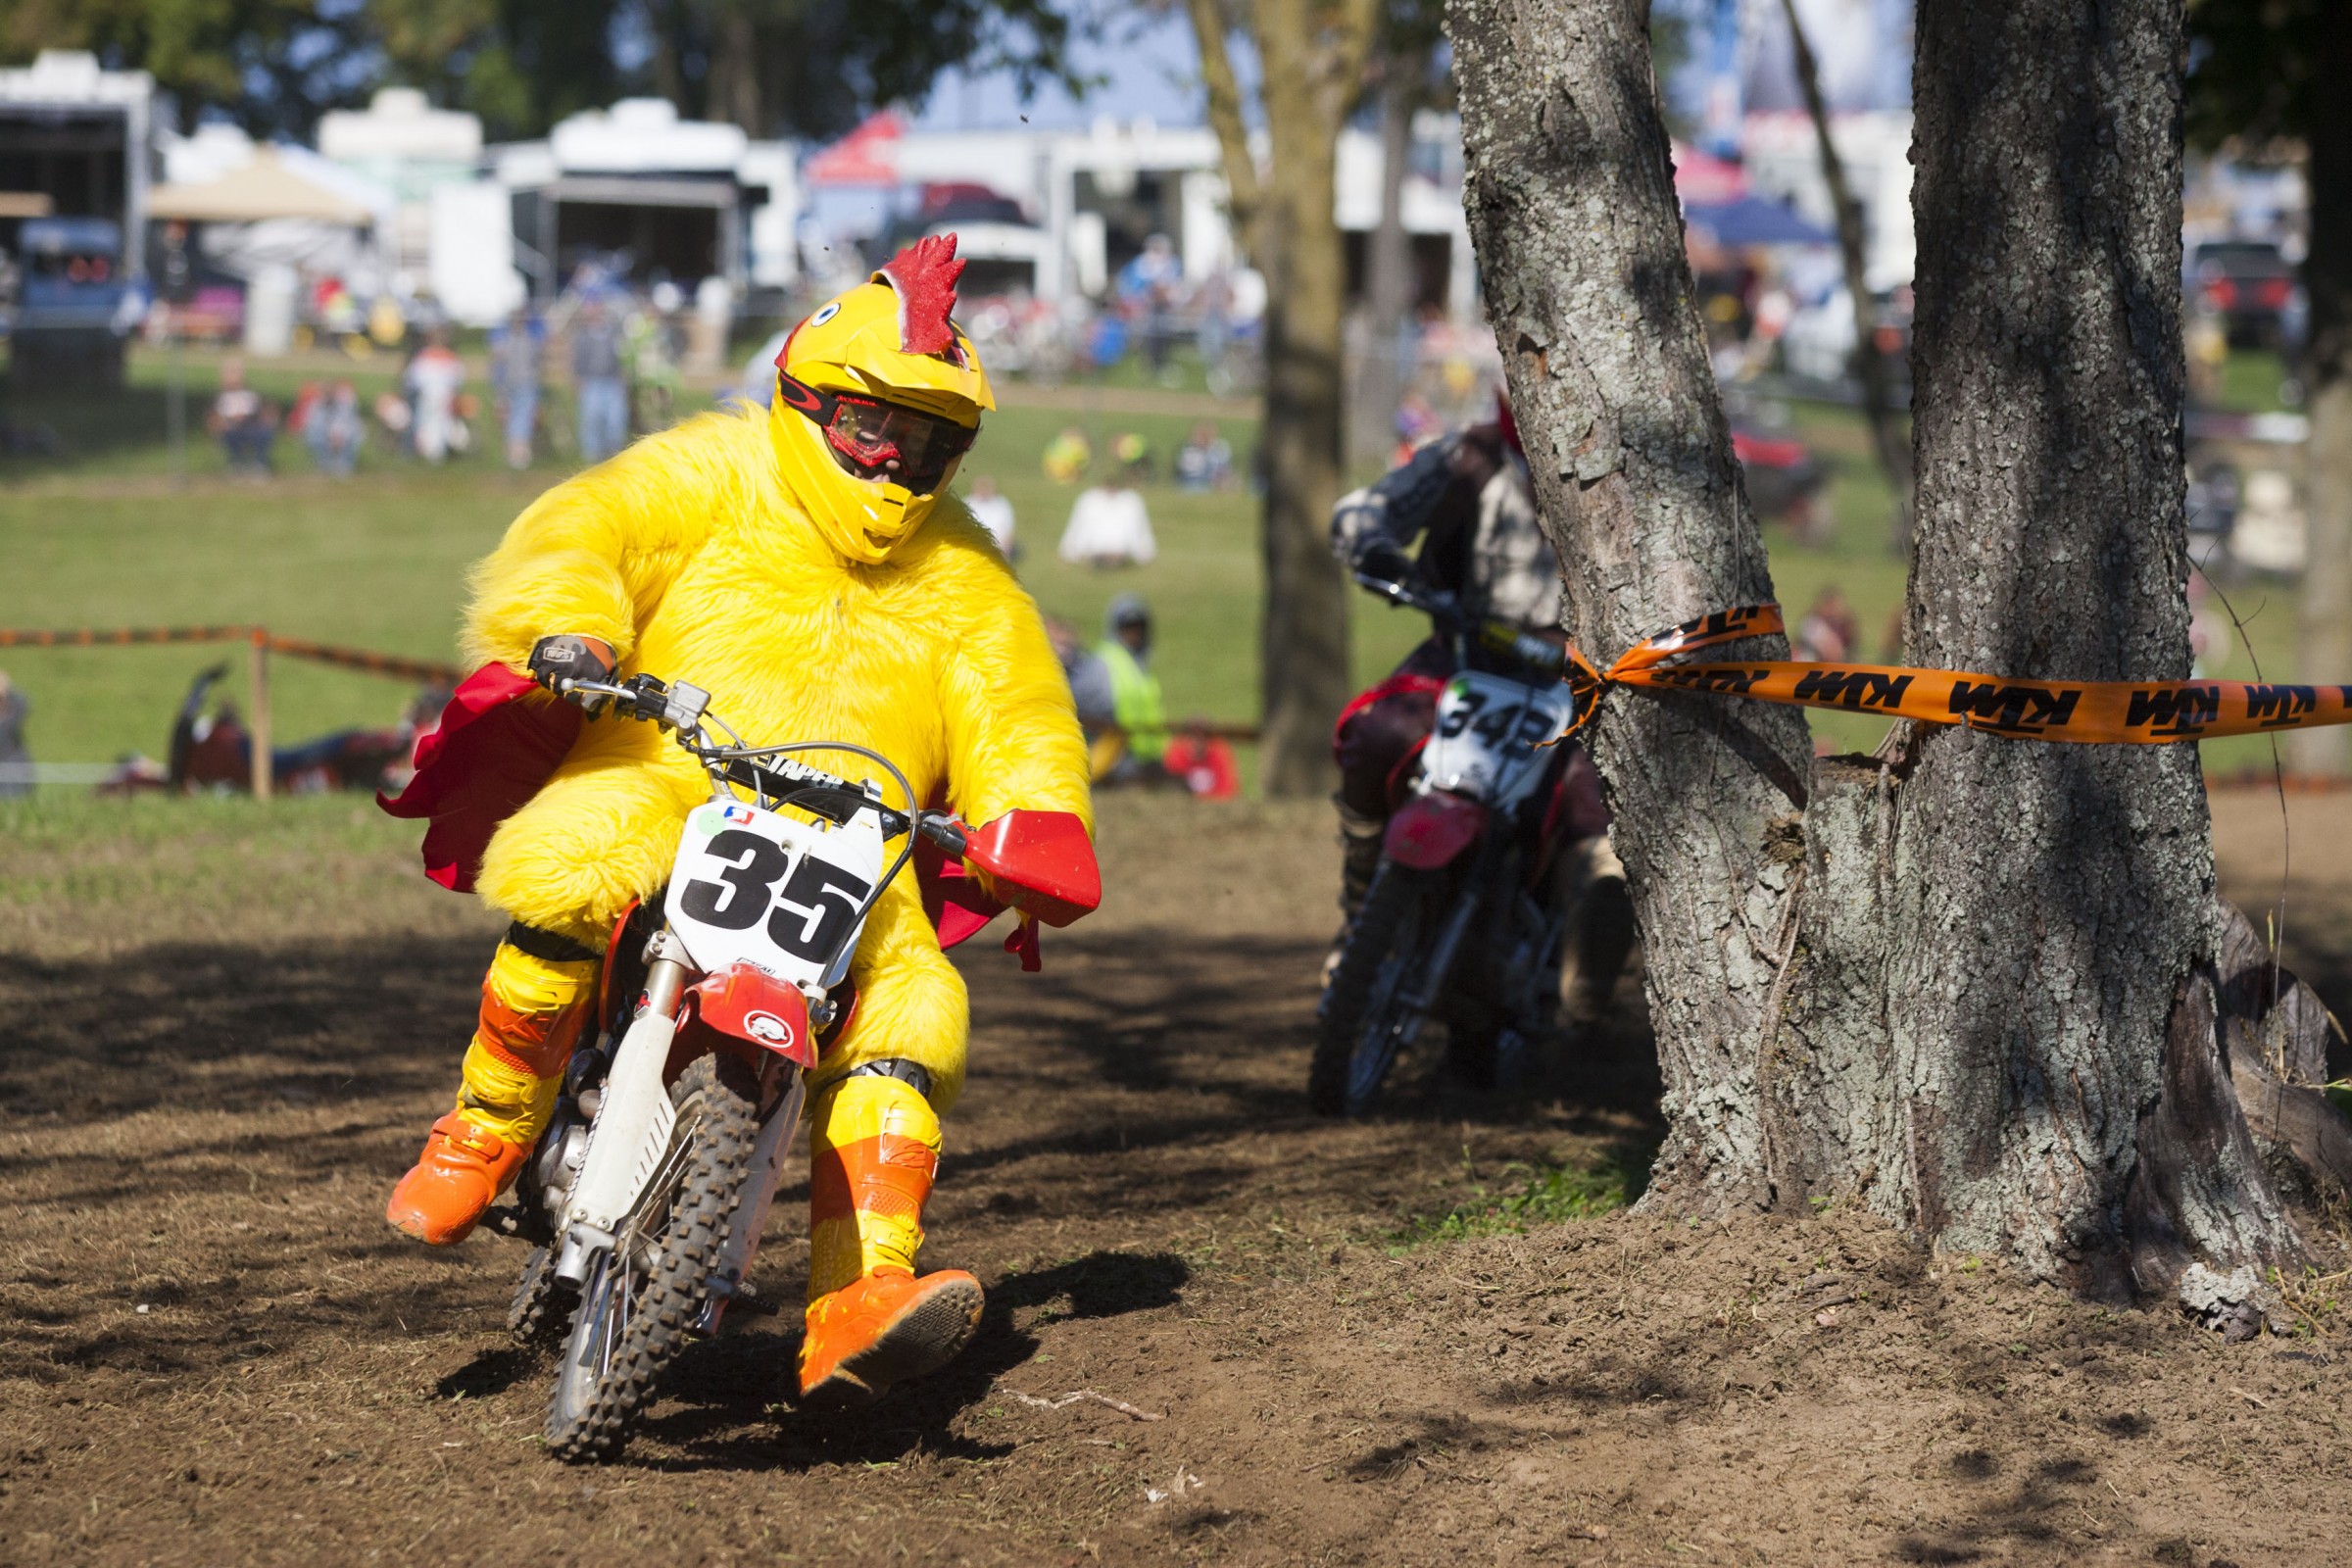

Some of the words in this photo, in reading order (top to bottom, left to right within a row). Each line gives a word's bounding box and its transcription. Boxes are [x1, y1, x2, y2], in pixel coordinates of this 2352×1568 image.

[1793, 669, 1916, 714] KTM
[1948, 680, 2082, 734] KTM
[2125, 685, 2220, 736] KTM
[2244, 685, 2317, 727] KTM
[680, 830, 871, 965] 35
